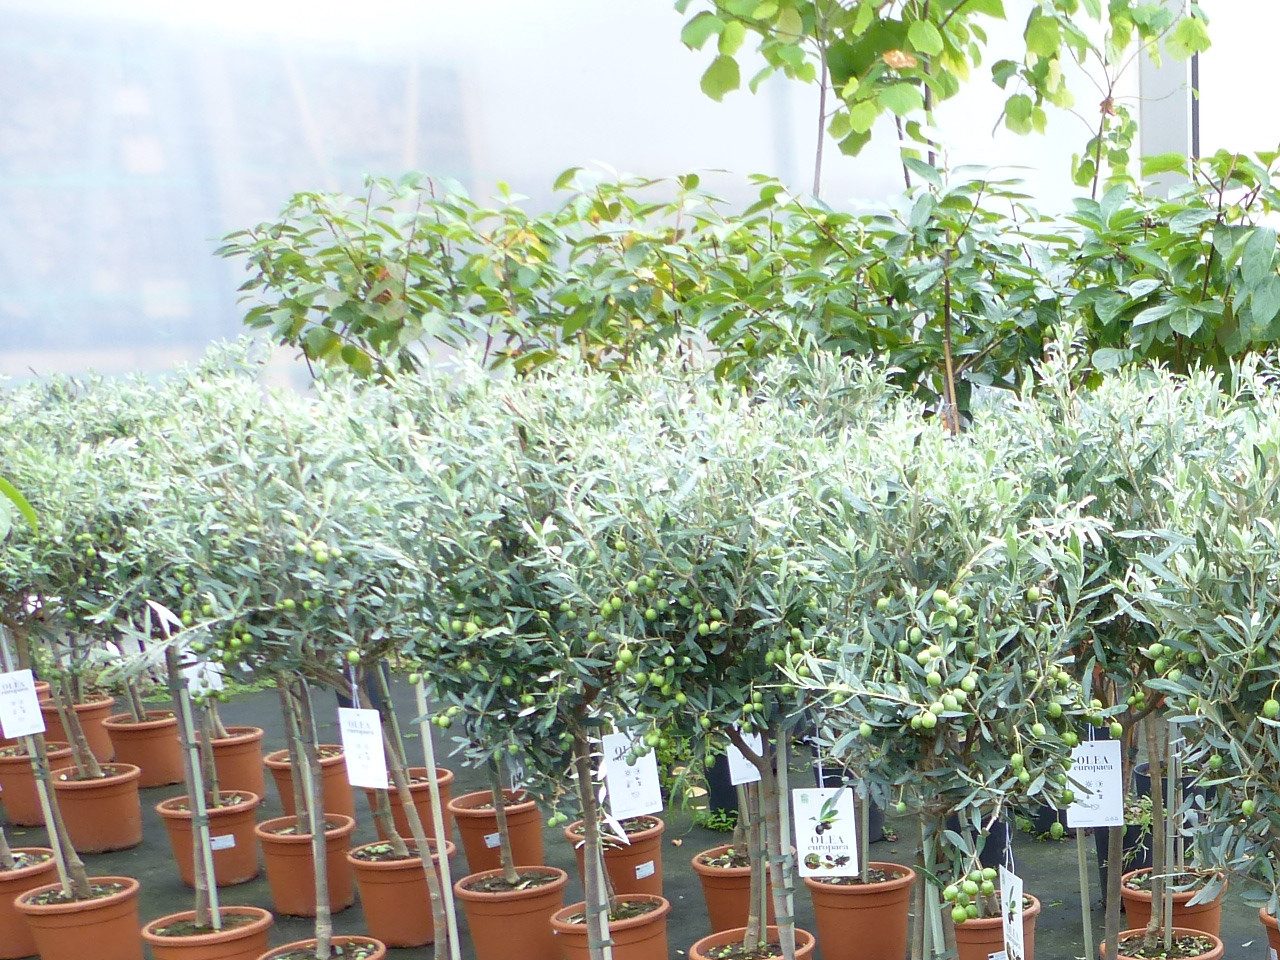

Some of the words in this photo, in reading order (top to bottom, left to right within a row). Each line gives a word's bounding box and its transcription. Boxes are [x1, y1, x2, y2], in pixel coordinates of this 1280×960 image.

[1077, 756, 1109, 764] OLEA
[1073, 764, 1113, 773] europaea
[811, 835, 844, 844] OLEA
[807, 845, 849, 853] europaea
